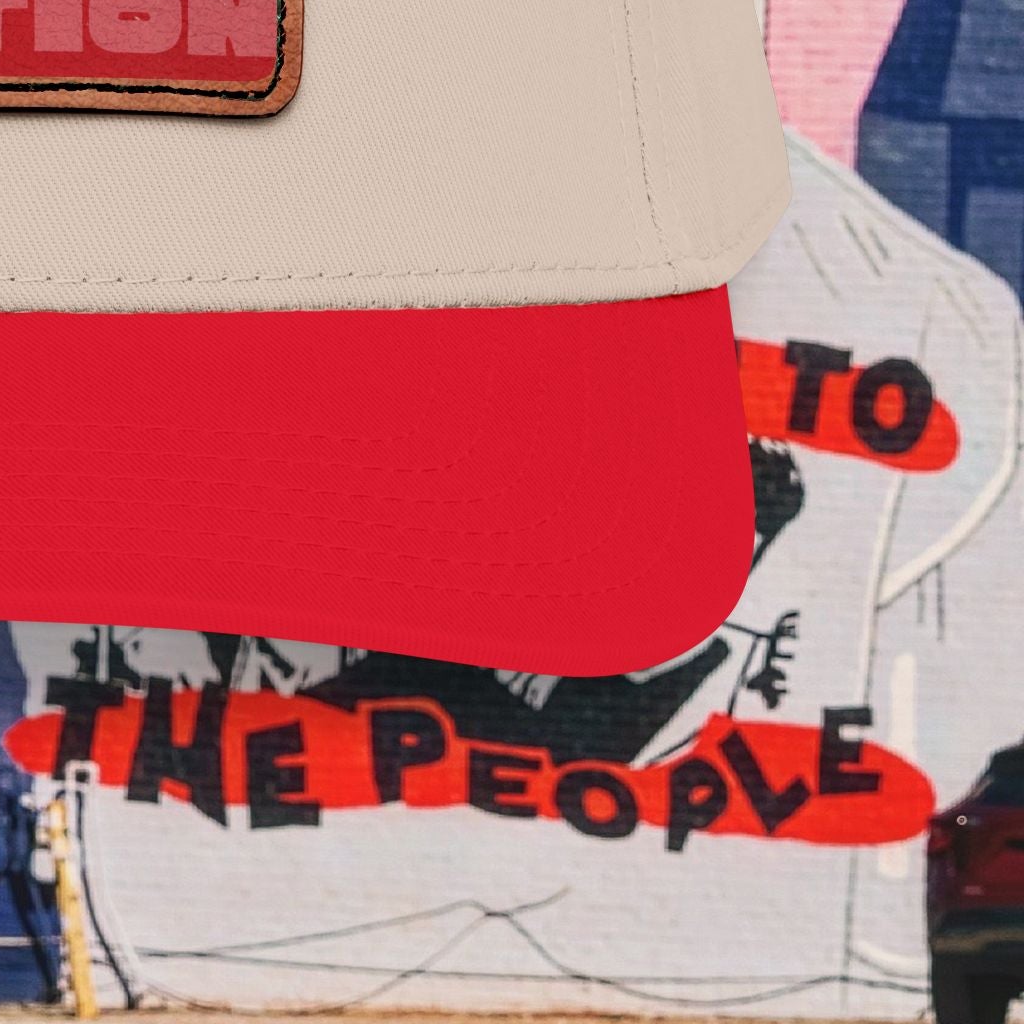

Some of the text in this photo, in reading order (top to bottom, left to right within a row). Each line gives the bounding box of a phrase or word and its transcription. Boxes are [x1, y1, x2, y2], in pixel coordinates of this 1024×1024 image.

[785, 340, 933, 454] TO
[45, 675, 881, 852] THE PEOPLE
